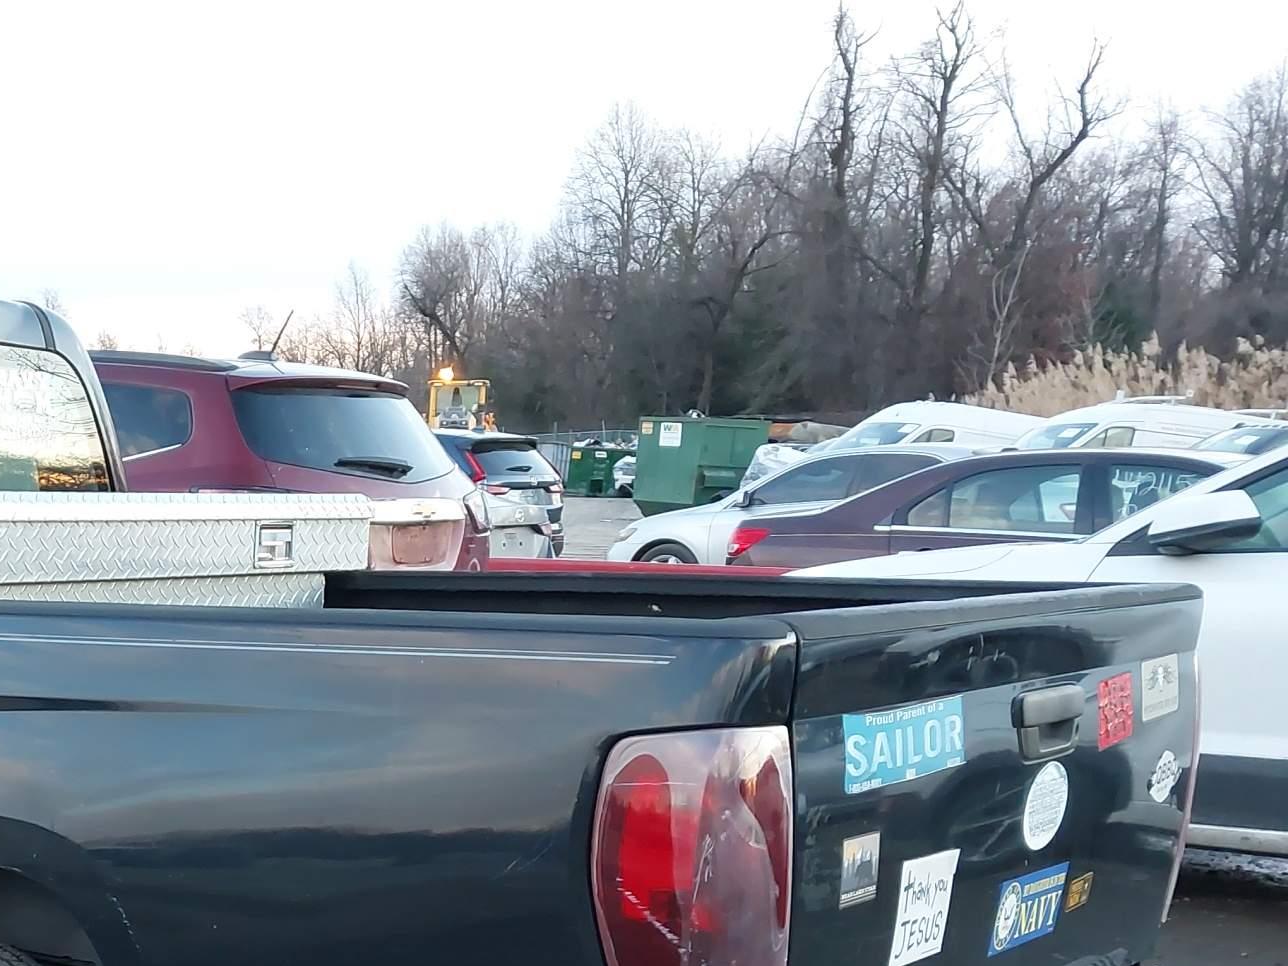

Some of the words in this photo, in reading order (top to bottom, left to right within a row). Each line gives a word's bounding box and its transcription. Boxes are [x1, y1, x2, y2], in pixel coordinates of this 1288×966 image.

[865, 713, 894, 727] Proud
[896, 706, 926, 721] Parent
[927, 702, 937, 713] of
[846, 714, 963, 777] SAILOR
[933, 878, 949, 908] you
[1013, 890, 1063, 939] NAVY
[894, 909, 943, 960] JESUS
